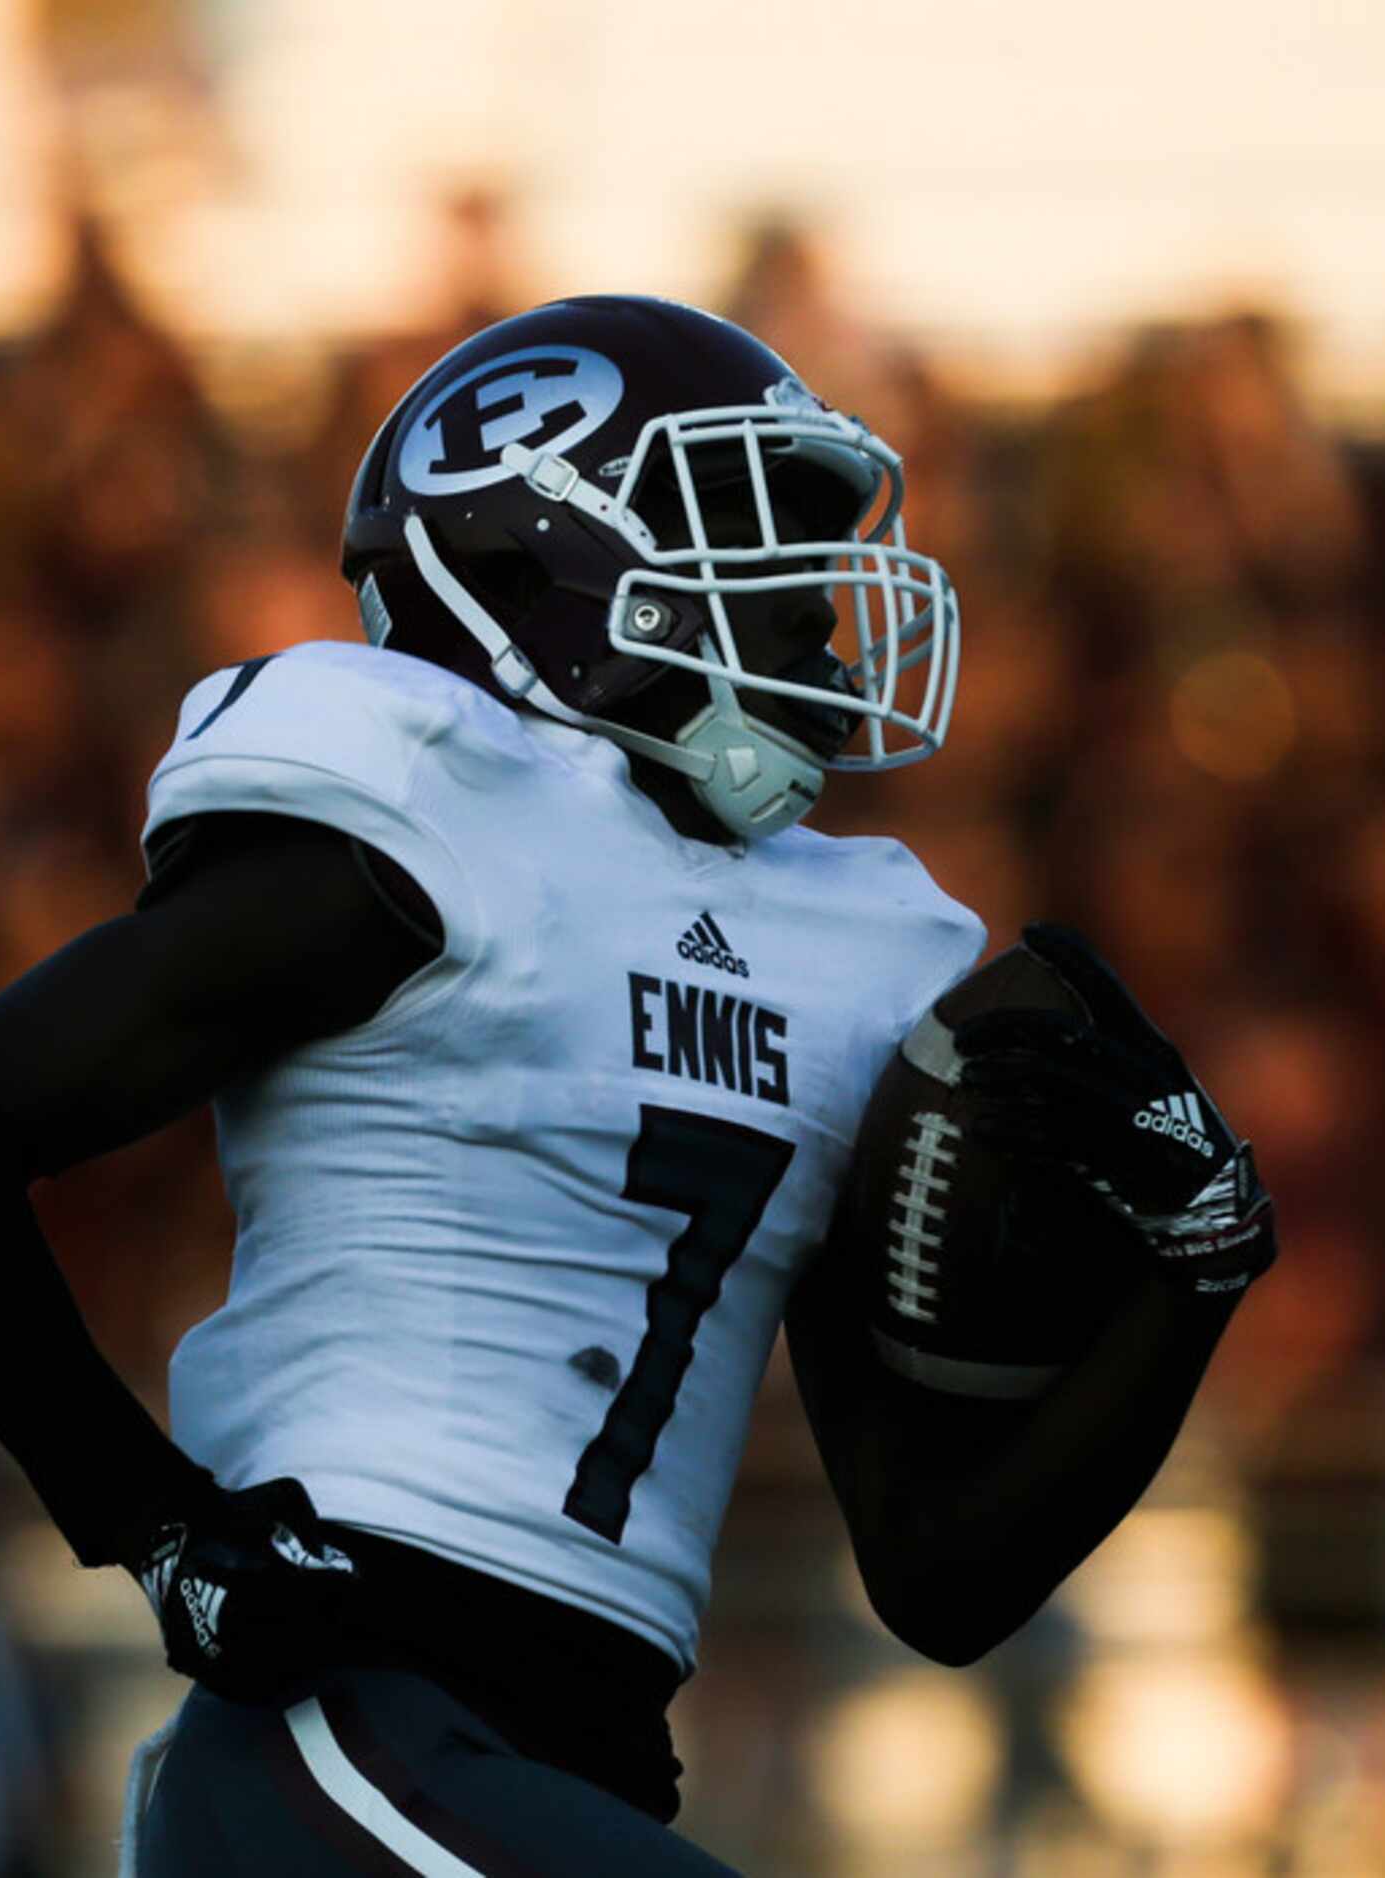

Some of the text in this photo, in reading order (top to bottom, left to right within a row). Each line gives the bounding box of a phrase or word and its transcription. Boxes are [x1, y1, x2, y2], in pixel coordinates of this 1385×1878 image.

[424, 358, 587, 474] E
[676, 940, 750, 979] adidas
[628, 971, 789, 1107] ENNIS
[1133, 1110, 1214, 1158] adidas
[562, 1103, 796, 1546] 7
